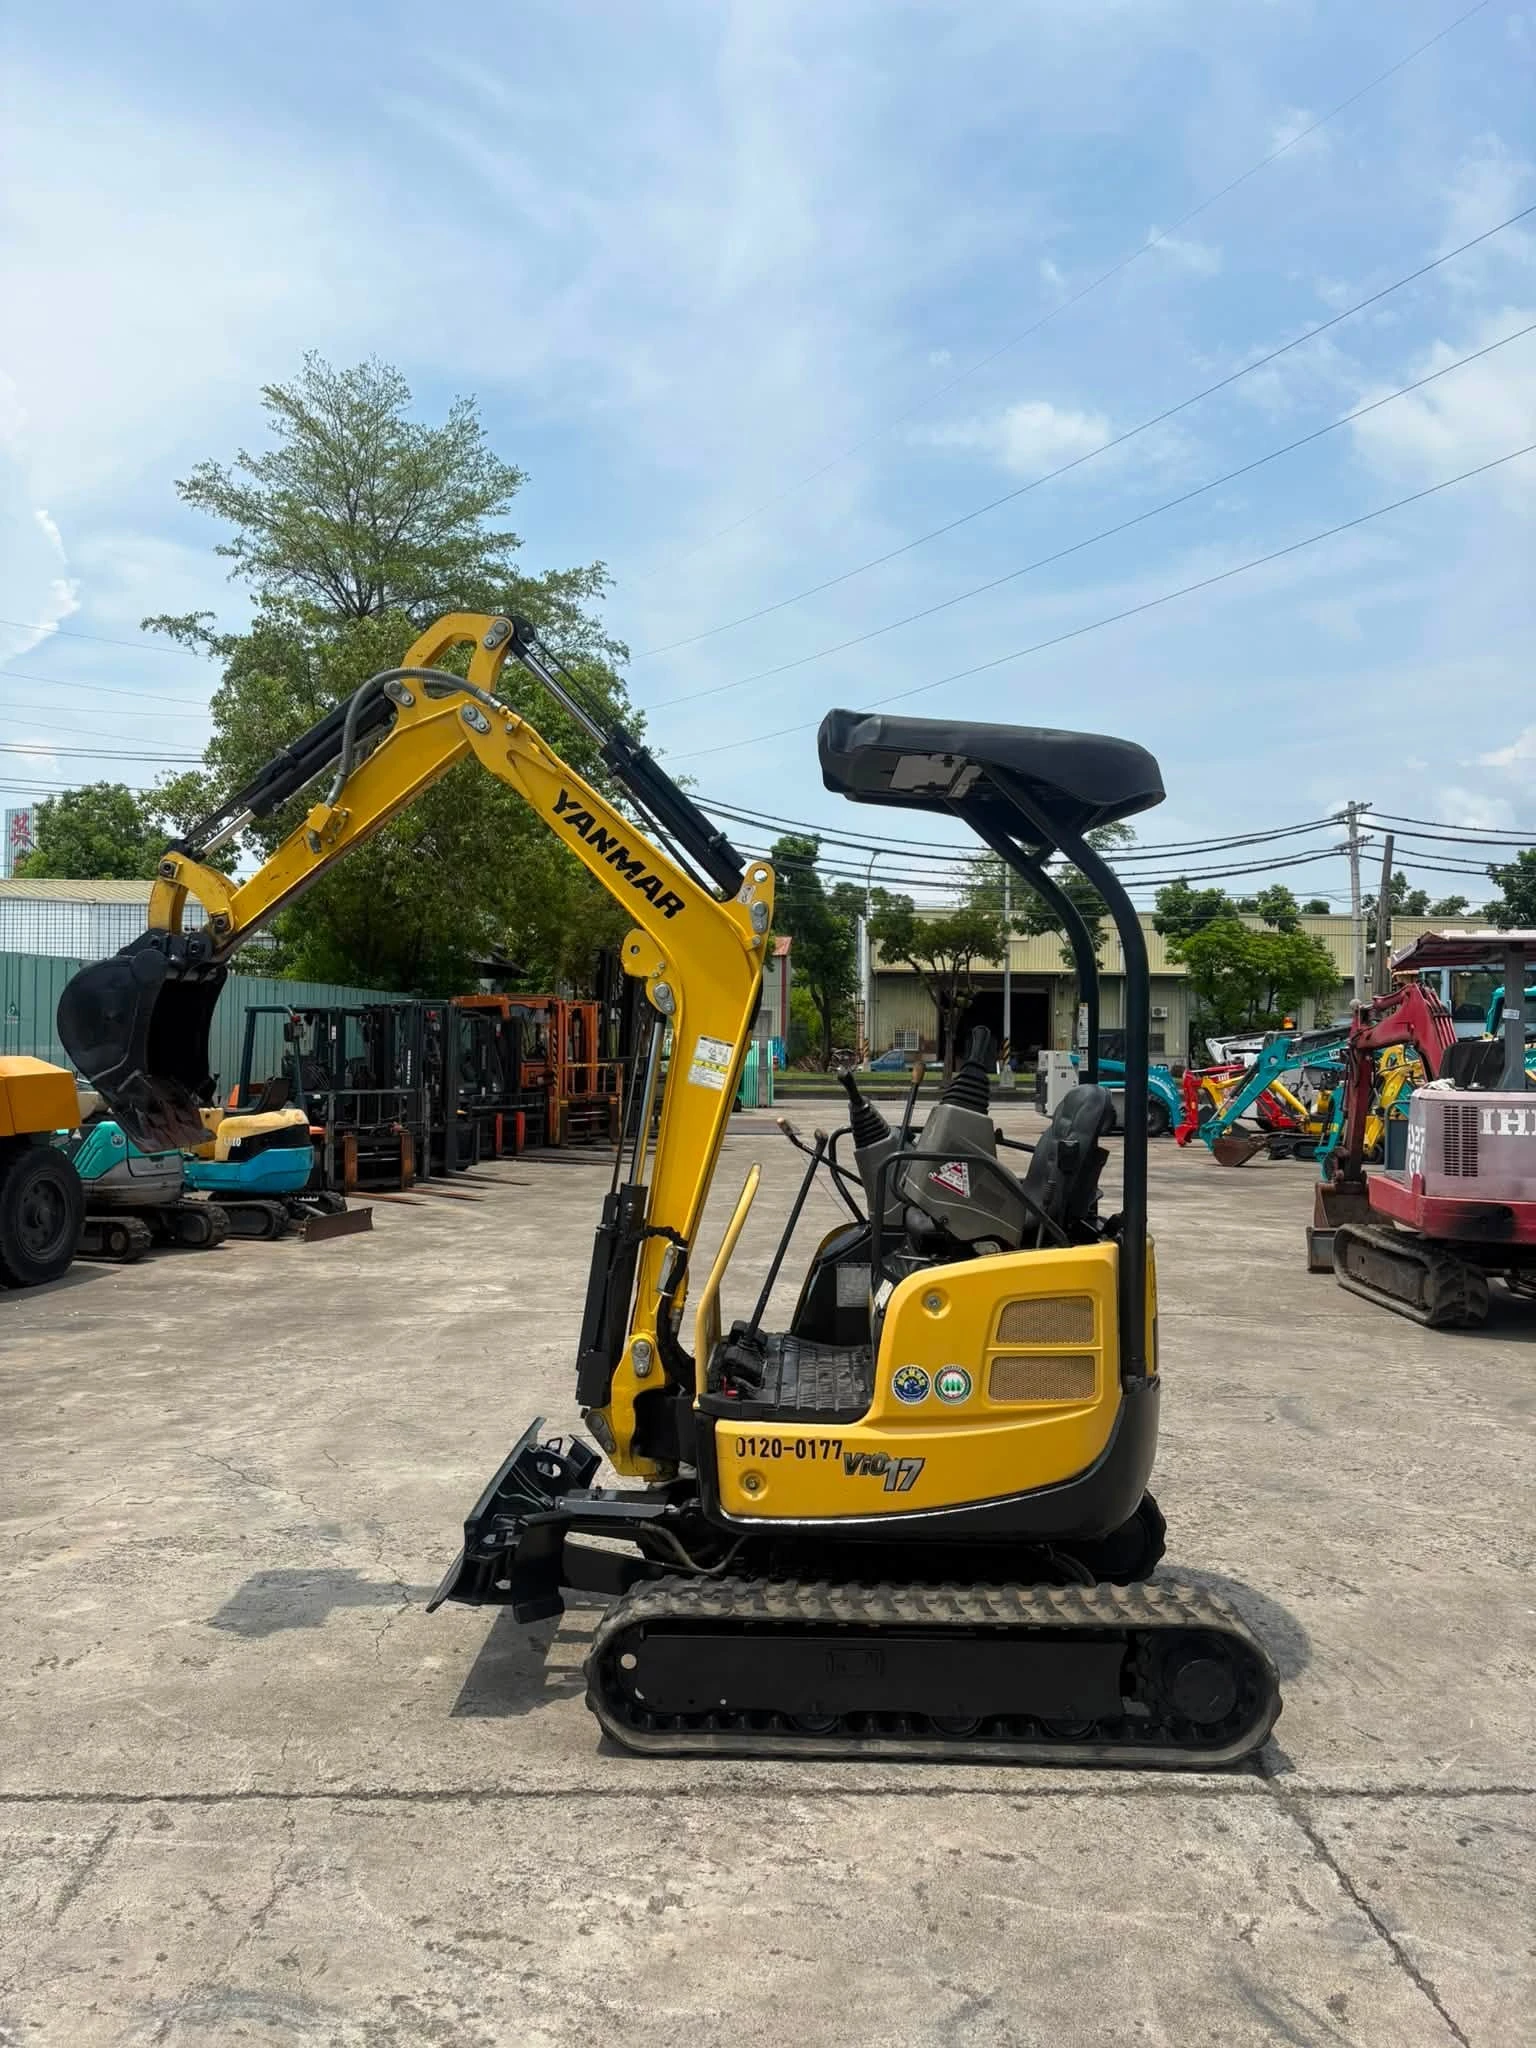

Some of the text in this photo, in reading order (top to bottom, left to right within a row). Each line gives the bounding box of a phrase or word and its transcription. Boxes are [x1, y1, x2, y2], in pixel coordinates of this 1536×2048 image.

[551, 788, 687, 919] YANMAR
[1480, 1108, 1536, 1136] IH
[736, 1437, 843, 1460] 0120-0177
